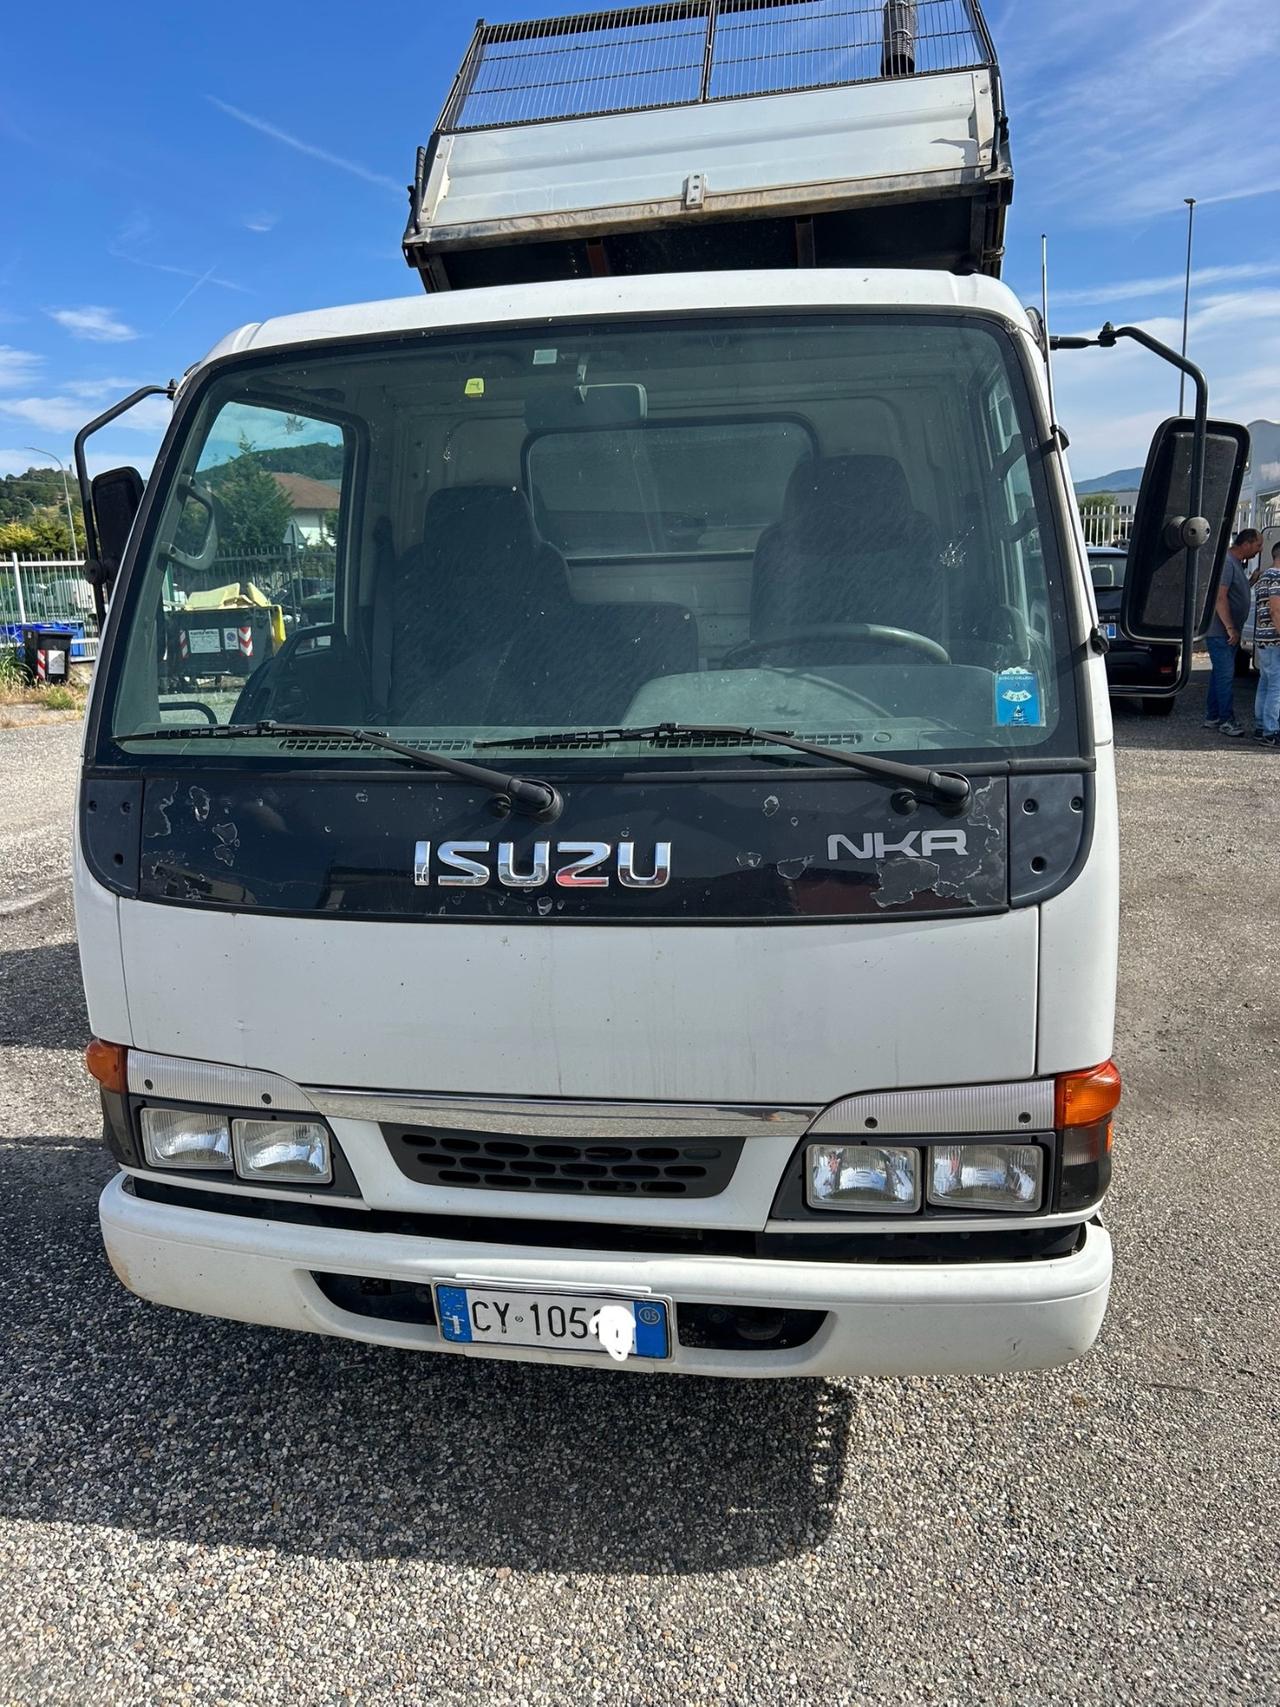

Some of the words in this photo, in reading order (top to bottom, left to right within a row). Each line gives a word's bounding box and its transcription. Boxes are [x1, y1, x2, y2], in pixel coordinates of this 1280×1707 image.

[827, 829, 969, 861] NKR
[414, 840, 672, 888] ISUZU
[472, 1300, 510, 1334] CY
[643, 1310, 658, 1321] 05
